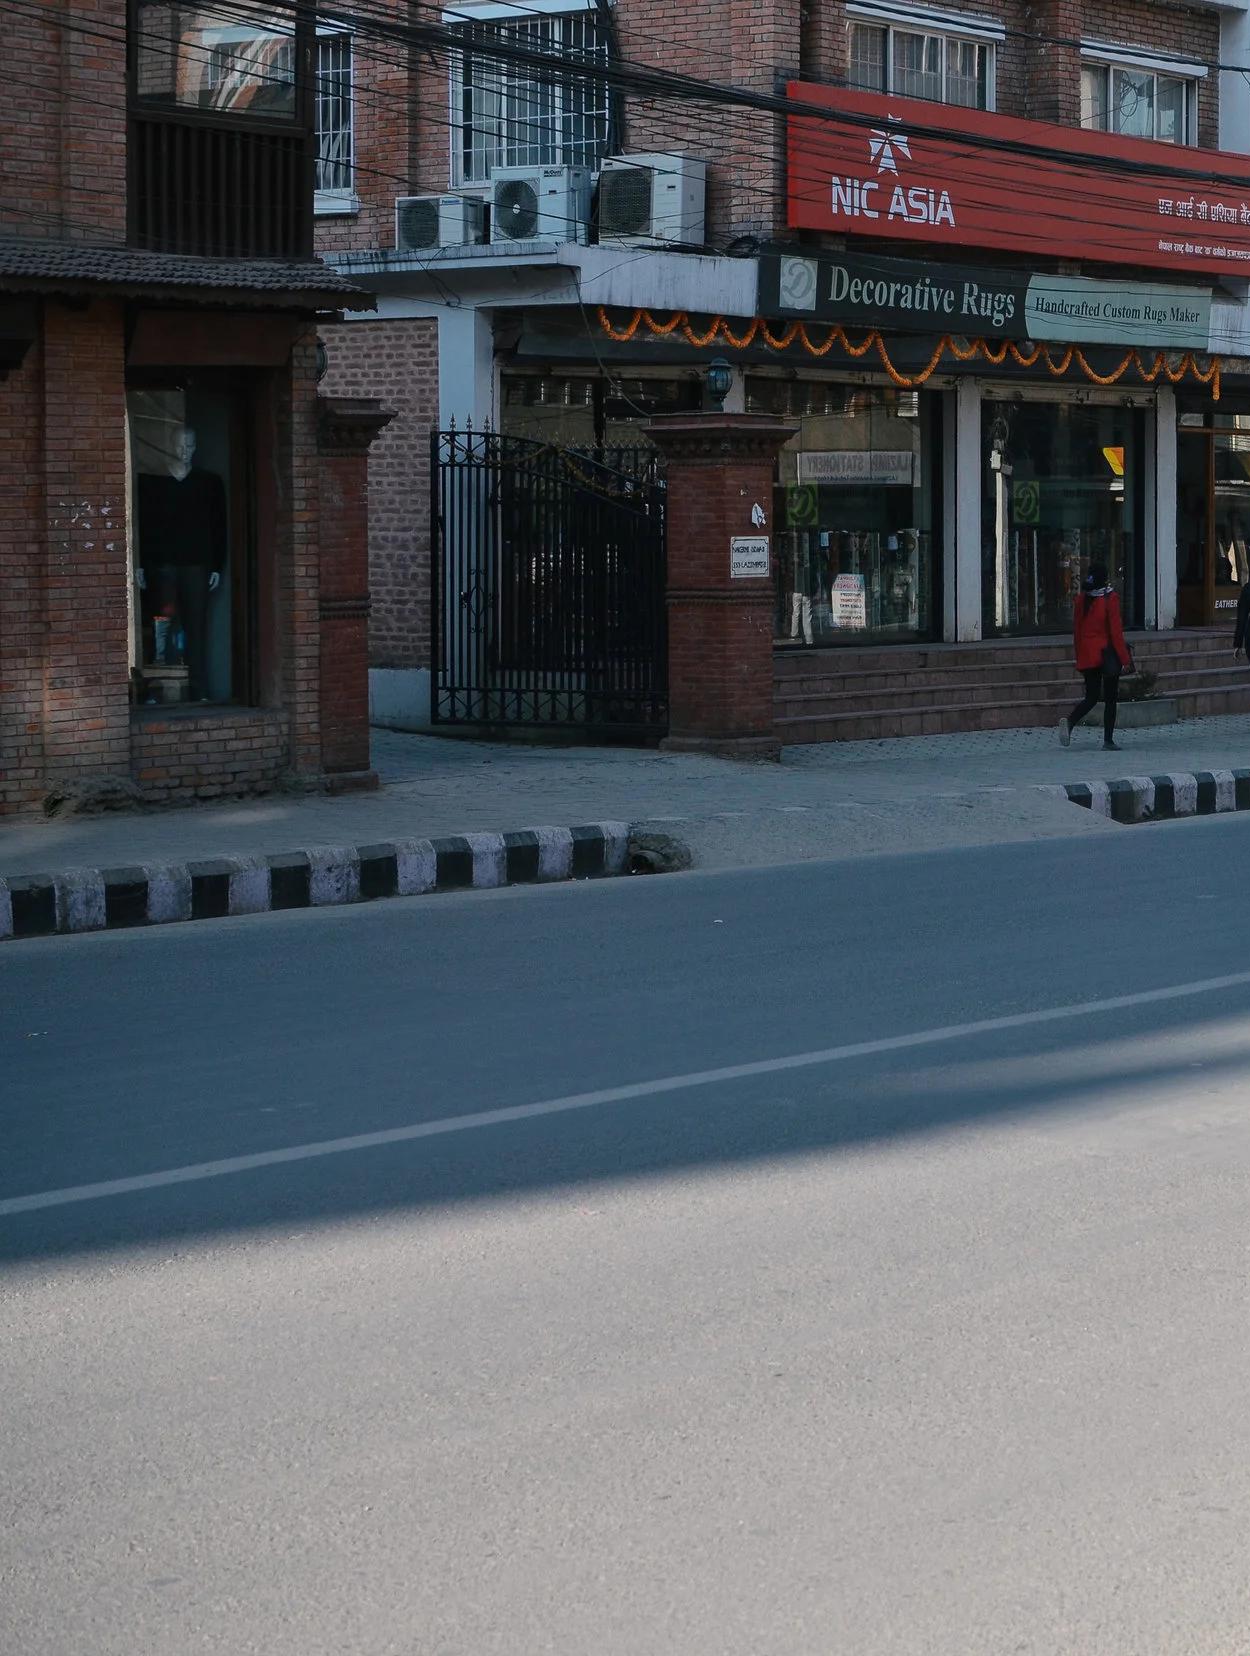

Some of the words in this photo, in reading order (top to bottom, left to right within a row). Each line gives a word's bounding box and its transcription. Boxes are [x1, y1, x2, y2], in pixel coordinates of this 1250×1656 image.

[831, 176, 879, 219] NIC
[887, 185, 956, 227] ASIA
[828, 265, 955, 313] Decorative
[960, 283, 1015, 327] Rugs
[1035, 297, 1101, 317] Handcrafted
[1103, 303, 1140, 320] Custom
[1143, 305, 1167, 324] Rugs
[1169, 307, 1201, 322] Maker
